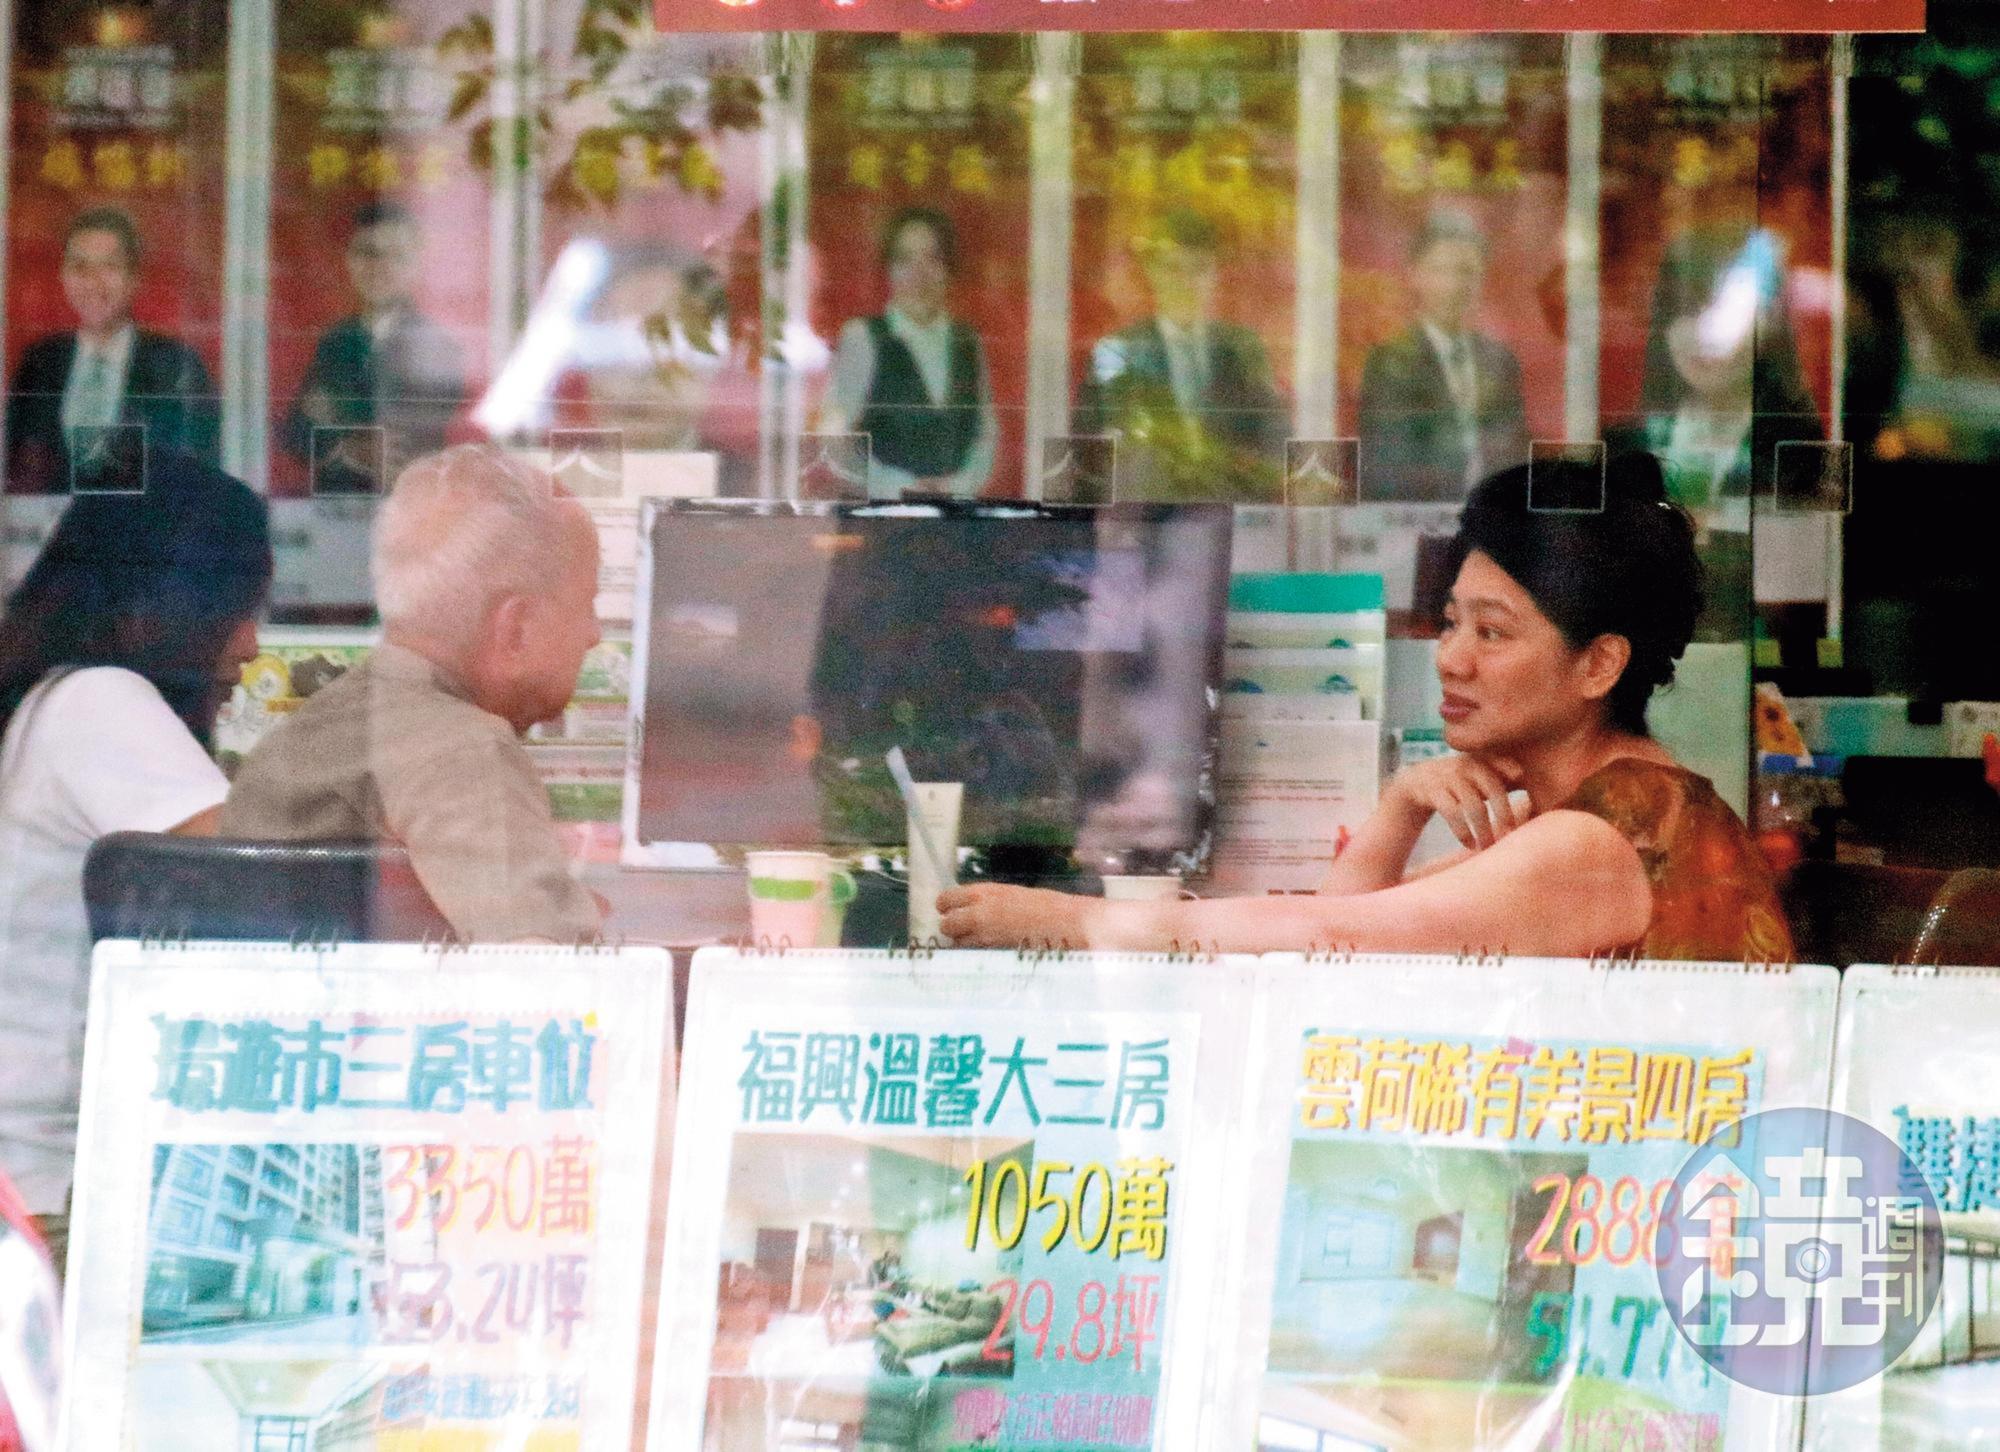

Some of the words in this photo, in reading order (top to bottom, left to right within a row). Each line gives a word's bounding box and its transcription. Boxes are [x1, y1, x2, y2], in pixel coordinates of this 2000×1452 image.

[738, 1030, 1170, 1130] 福興溫馨大三房
[1300, 1034, 1754, 1148] 雲荷稀有美景四房
[963, 1157, 1174, 1261] 1050萬
[981, 1274, 1161, 1372] 29.8坪
